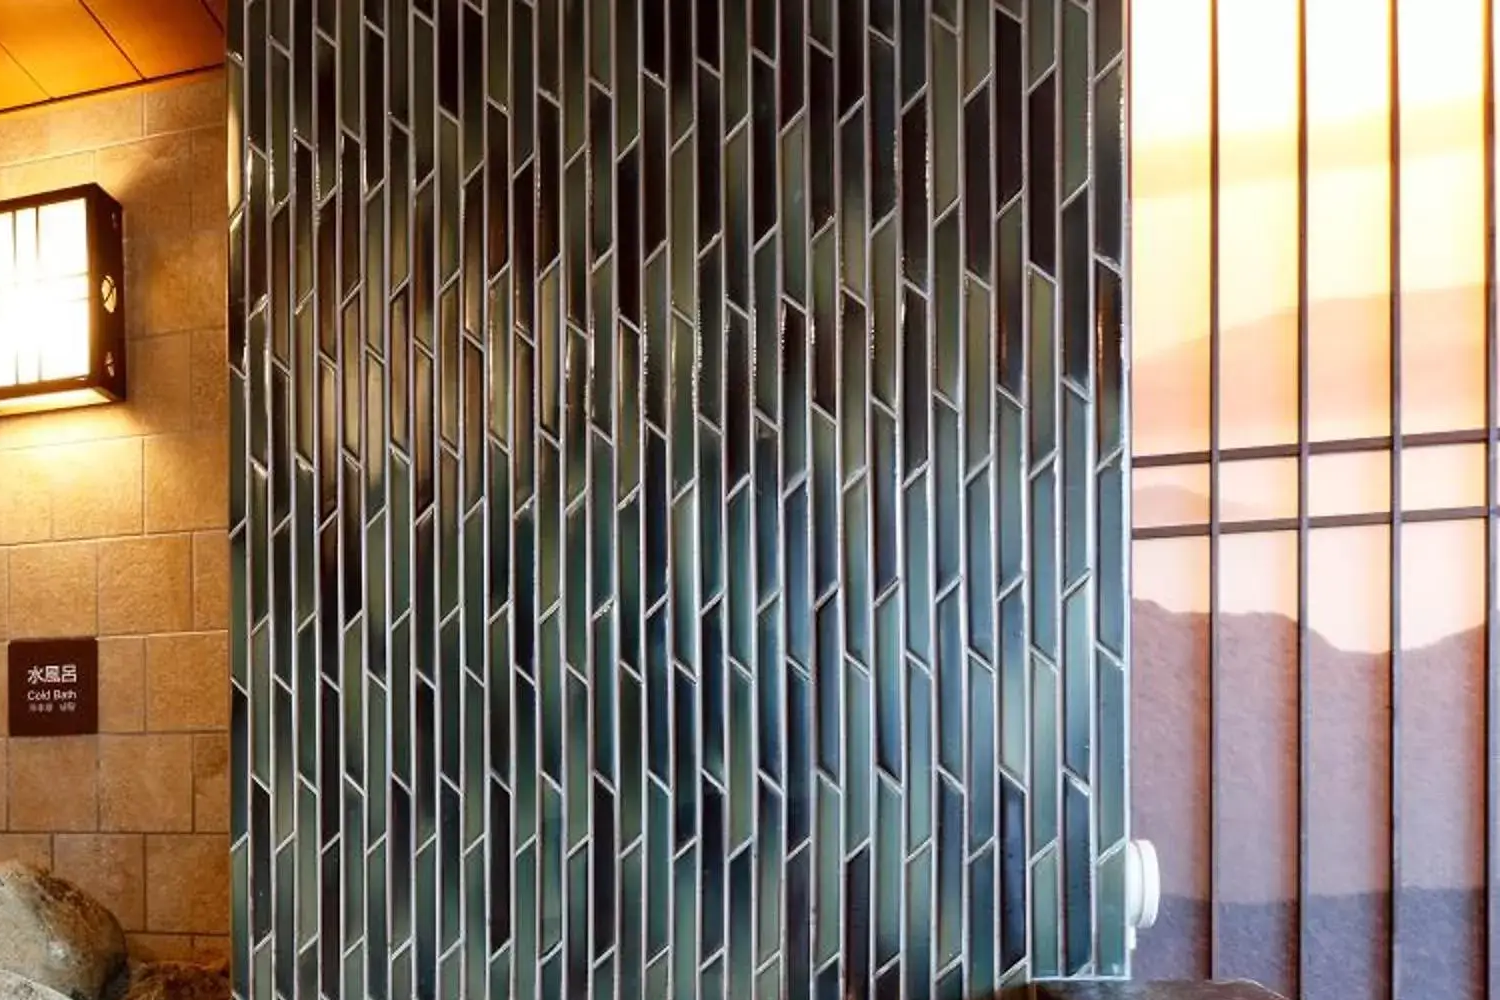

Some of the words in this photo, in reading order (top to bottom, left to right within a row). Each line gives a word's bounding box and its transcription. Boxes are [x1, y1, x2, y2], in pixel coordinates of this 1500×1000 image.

[27, 665, 77, 684] 水風呂
[27, 689, 51, 701] Cold
[53, 689, 77, 700] Bath
